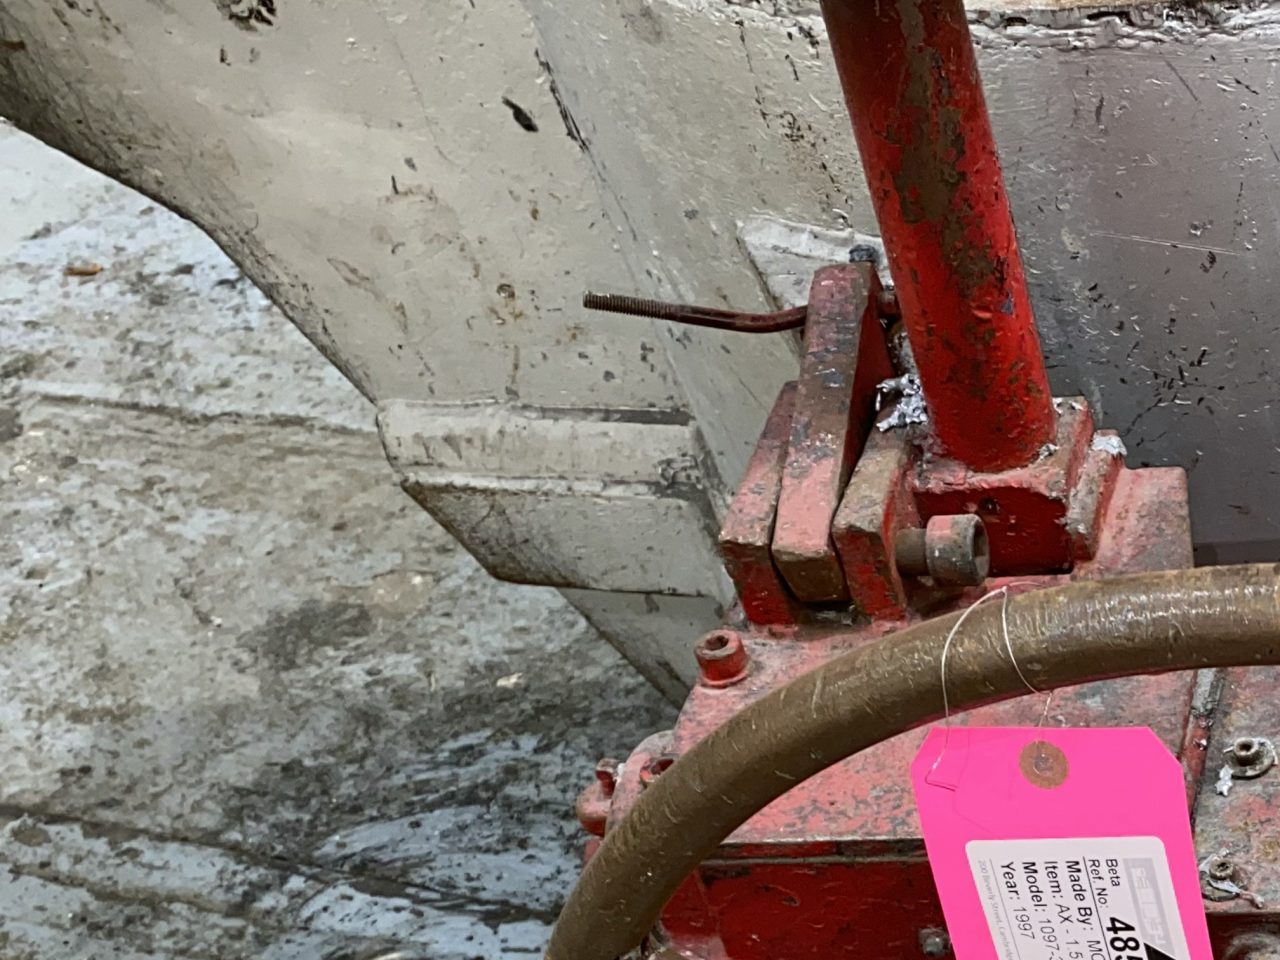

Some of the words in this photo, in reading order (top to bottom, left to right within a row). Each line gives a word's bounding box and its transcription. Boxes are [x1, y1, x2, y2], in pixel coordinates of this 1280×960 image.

[1022, 861, 1047, 911] Model:
[1065, 860, 1086, 901] Made
[1076, 906, 1092, 929] By:
[1088, 859, 1104, 882] Ref.
[1105, 858, 1120, 886] Beta
[1000, 861, 1019, 899] Year:
[1013, 906, 1035, 939] 1997
[1044, 861, 1062, 897] Item:
[1055, 903, 1073, 923] AX
[1065, 939, 1083, 959] 1.5
[1095, 887, 1109, 908] No:
